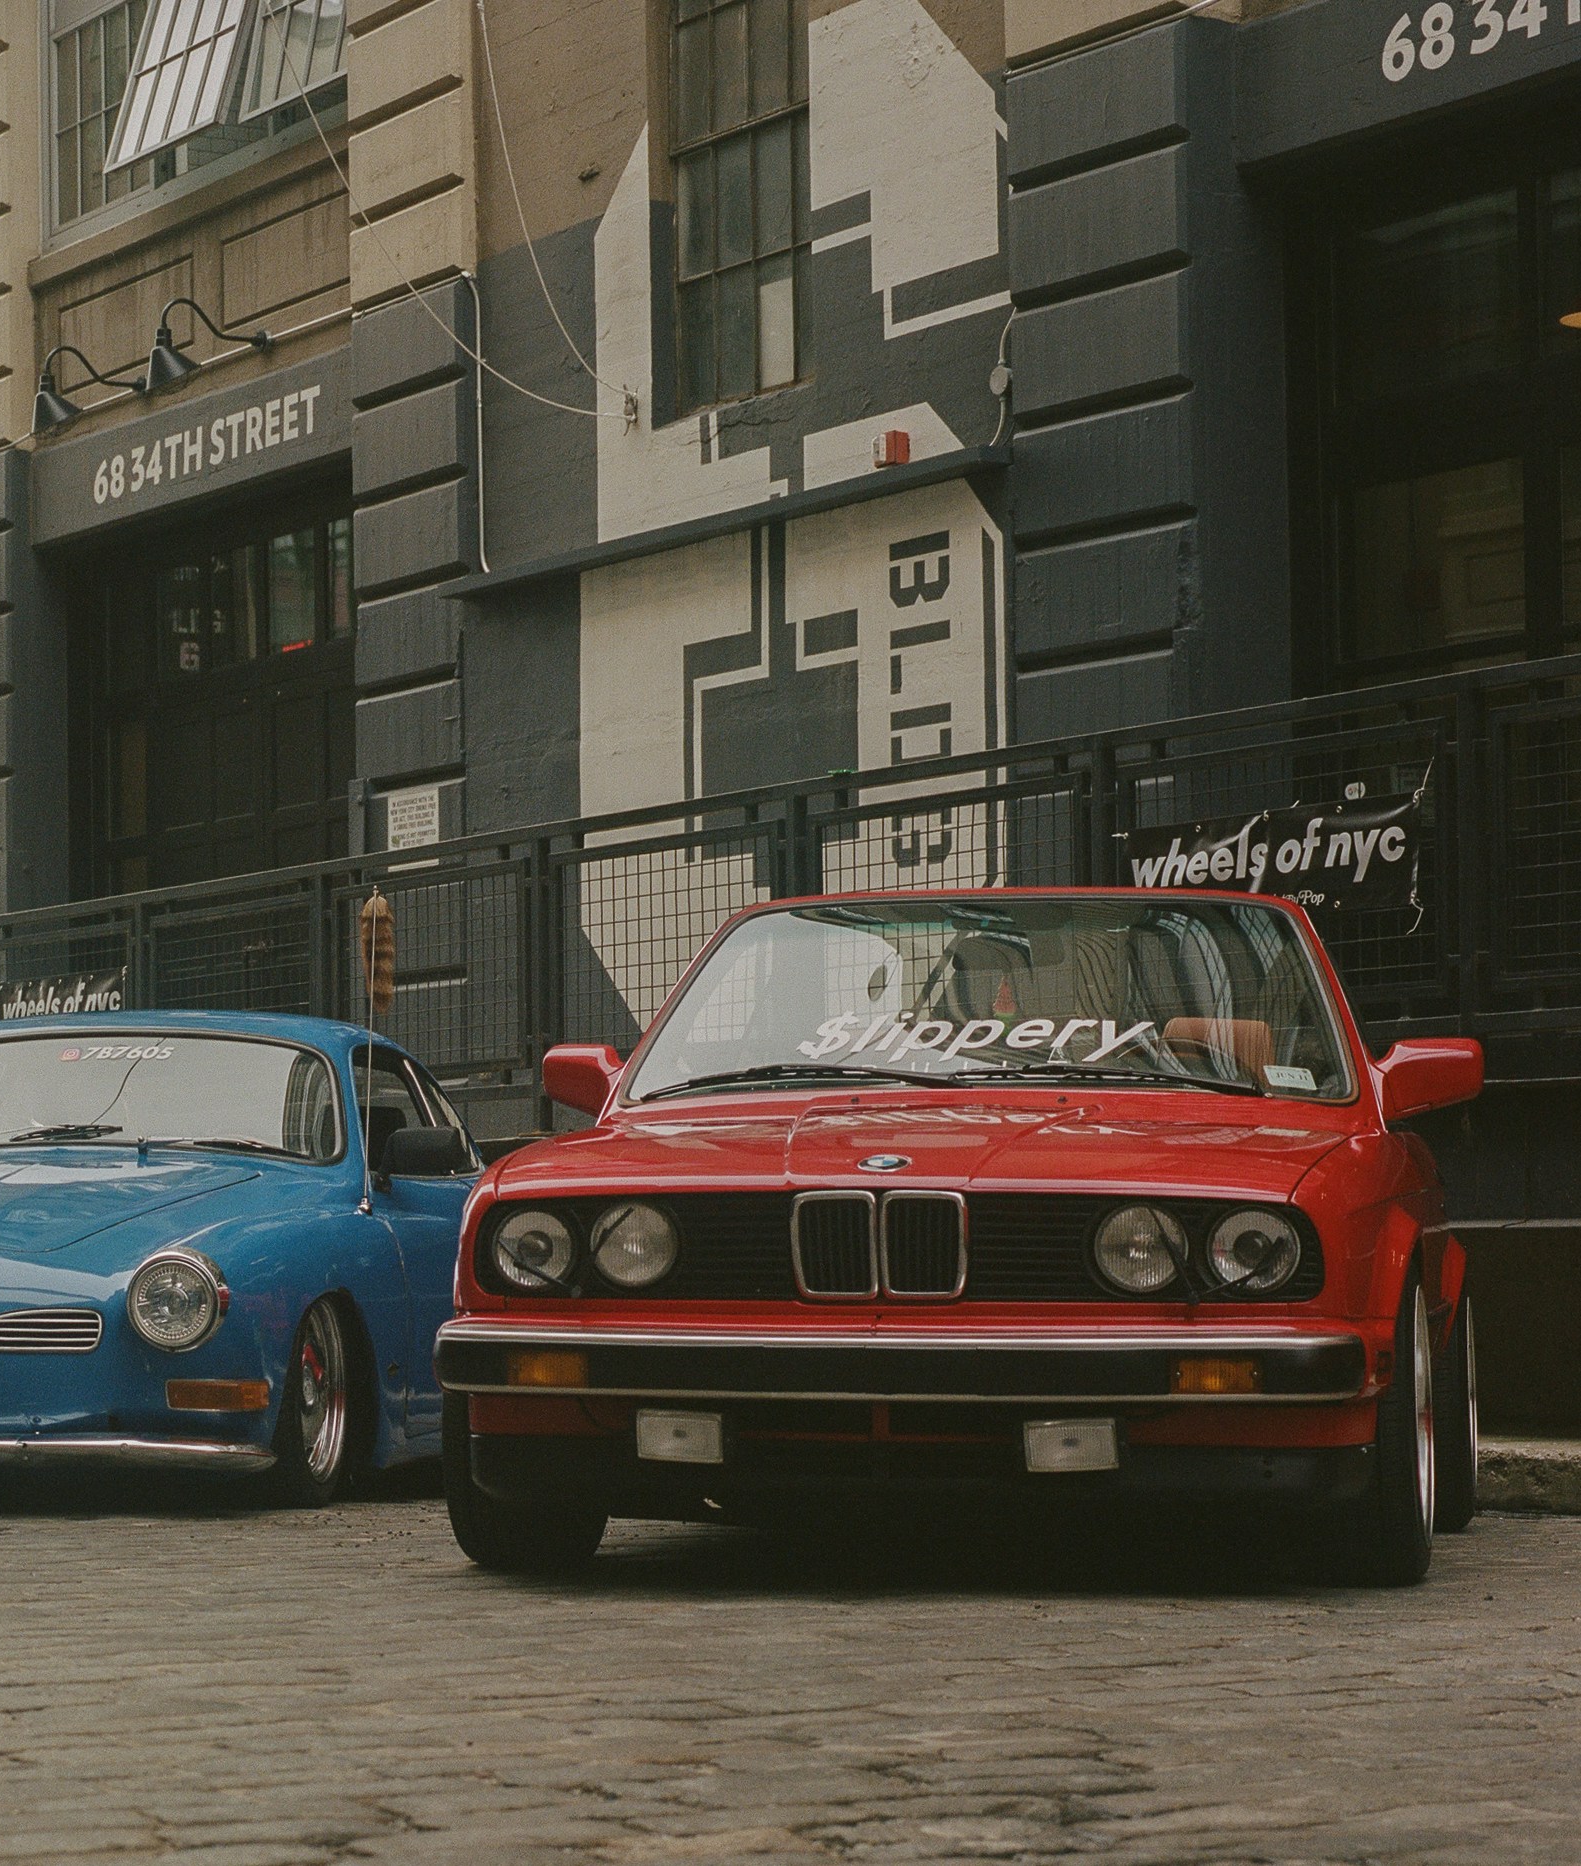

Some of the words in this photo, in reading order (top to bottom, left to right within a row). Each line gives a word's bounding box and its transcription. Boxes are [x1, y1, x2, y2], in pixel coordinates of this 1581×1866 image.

[1381, 1, 1456, 83] 68
[1469, 0, 1581, 56] 34
[93, 455, 126, 505] 68
[130, 425, 204, 493] 34TH
[209, 384, 322, 466] STREET
[1131, 829, 1268, 888] wheels
[1275, 817, 1323, 875] of
[1324, 822, 1406, 882] nyc
[2, 985, 61, 1020] wheels
[62, 979, 86, 1013] of
[796, 1010, 1155, 1064] $lippery
